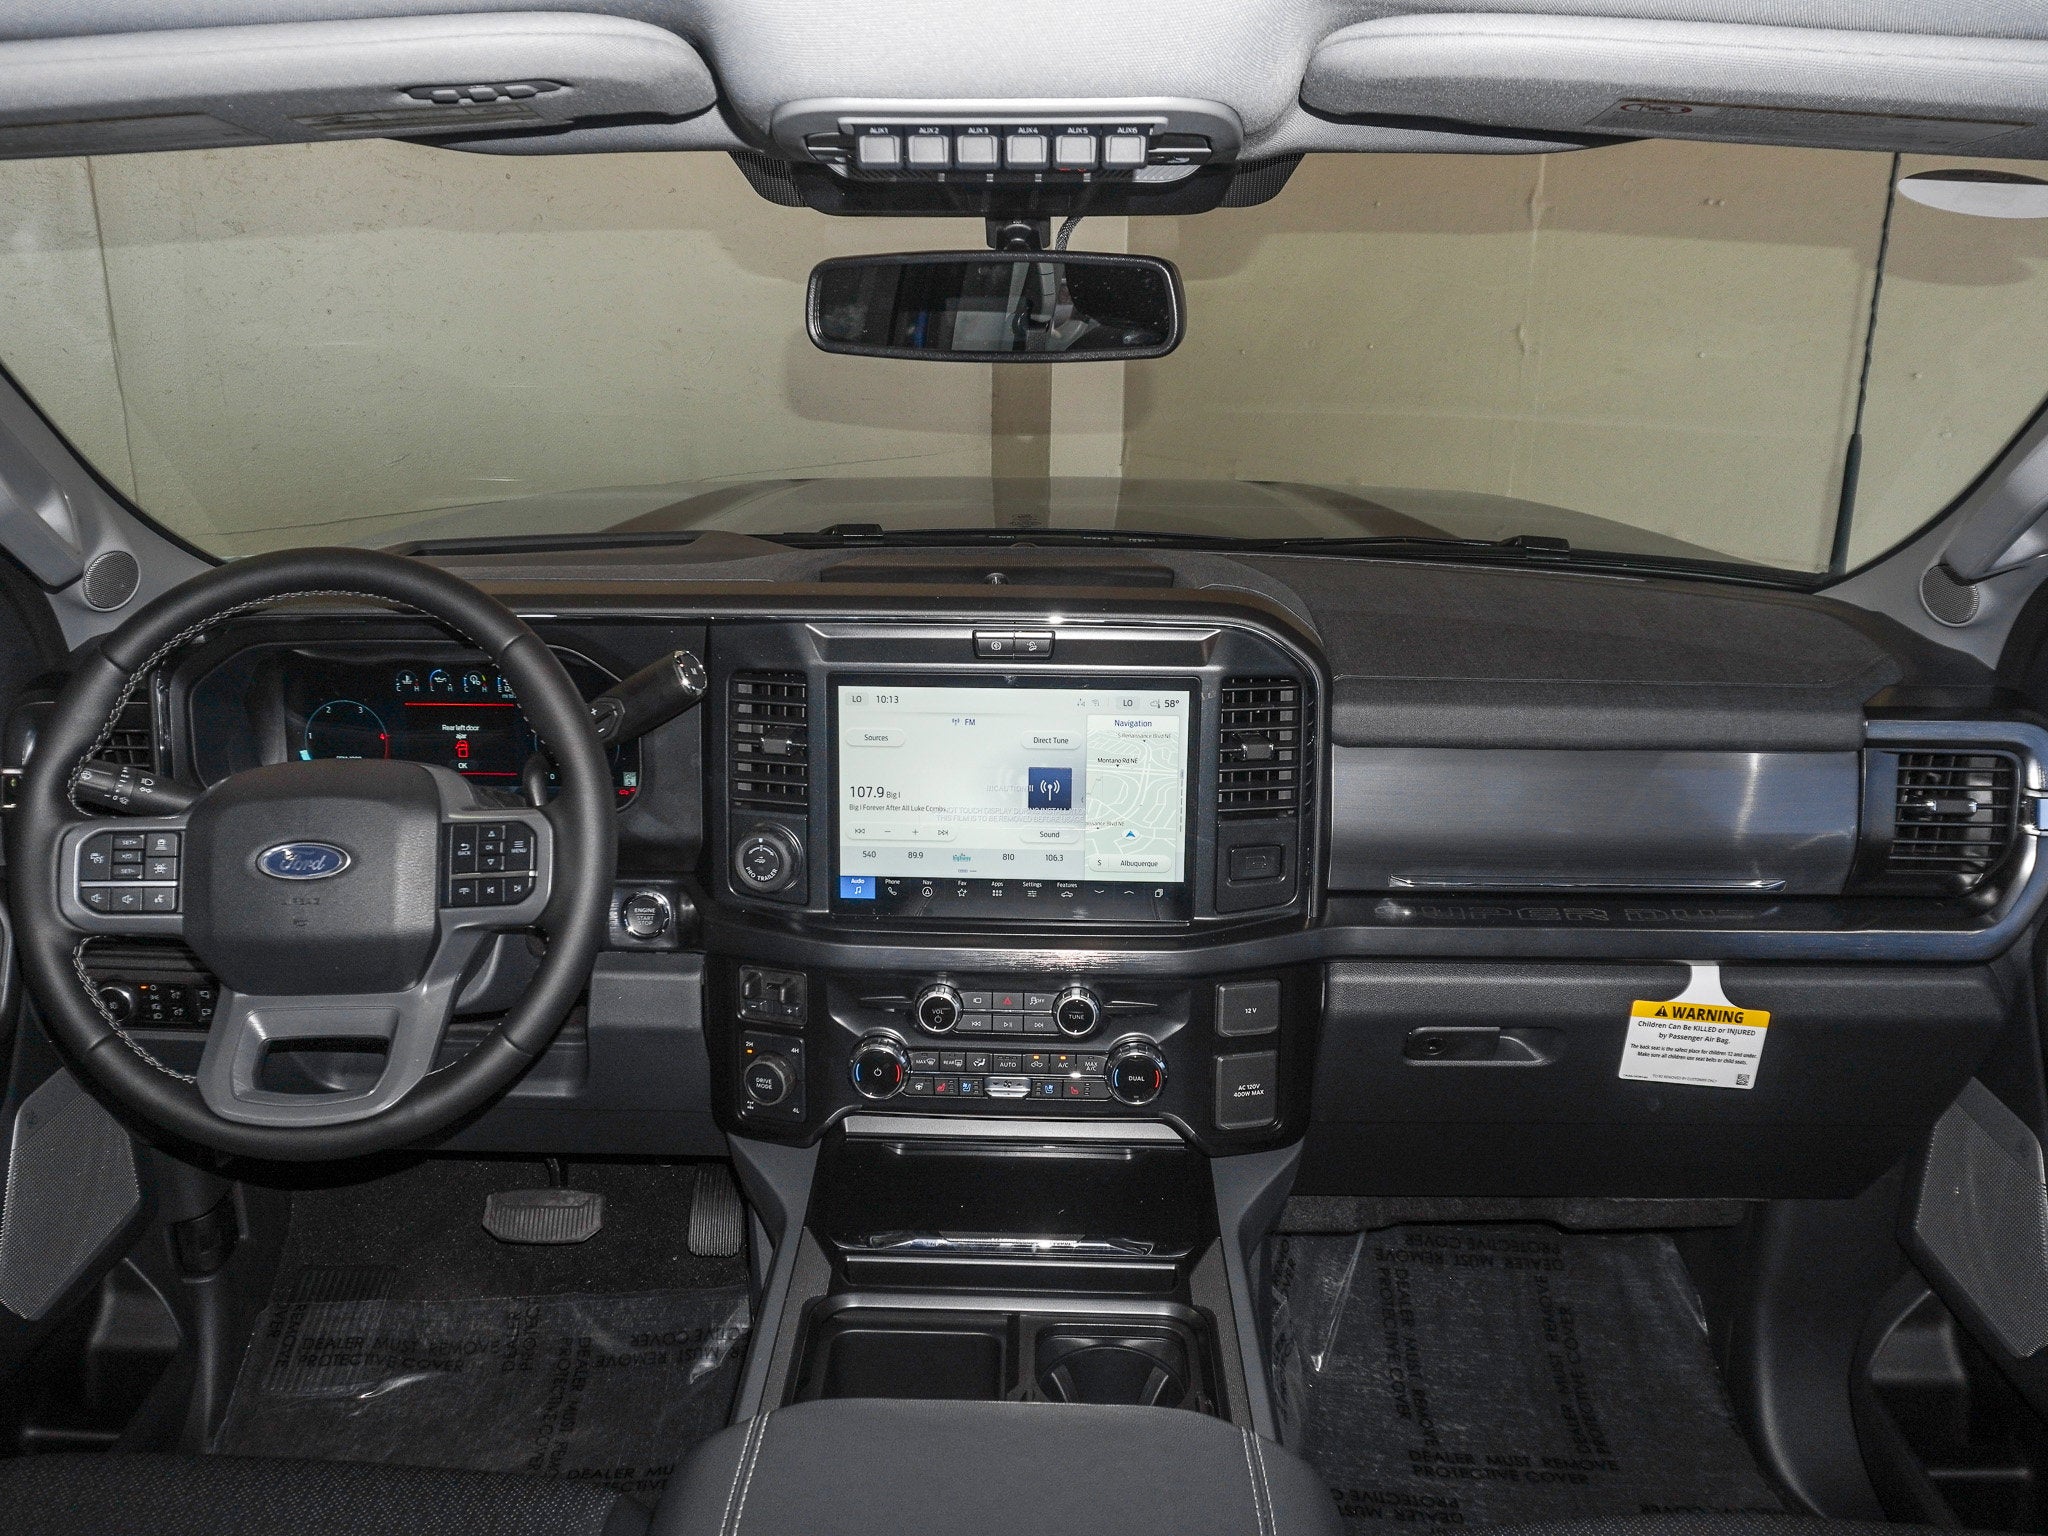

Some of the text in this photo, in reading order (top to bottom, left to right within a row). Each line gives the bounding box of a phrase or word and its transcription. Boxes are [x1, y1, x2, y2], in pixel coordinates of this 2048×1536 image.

[876, 696, 899, 704] 10:13
[1114, 720, 1152, 728] Navigation
[850, 786, 884, 798] 107.9
[886, 792, 897, 800] Big
[908, 851, 924, 859] 89.9
[1002, 853, 1015, 861] 810
[1046, 854, 1064, 862] 106.3
[280, 851, 328, 871] Ford
[1120, 860, 1158, 868] Albuquerque
[746, 866, 778, 881] PRO TRAILER
[1672, 1006, 1744, 1024] WARNING
[1638, 1020, 1667, 1029] Children
[1693, 1025, 1716, 1033] KILLED
[1727, 1028, 1756, 1036] INJURED
[1668, 1034, 1703, 1042] Passenger
[1716, 1037, 1730, 1045] Bag.
